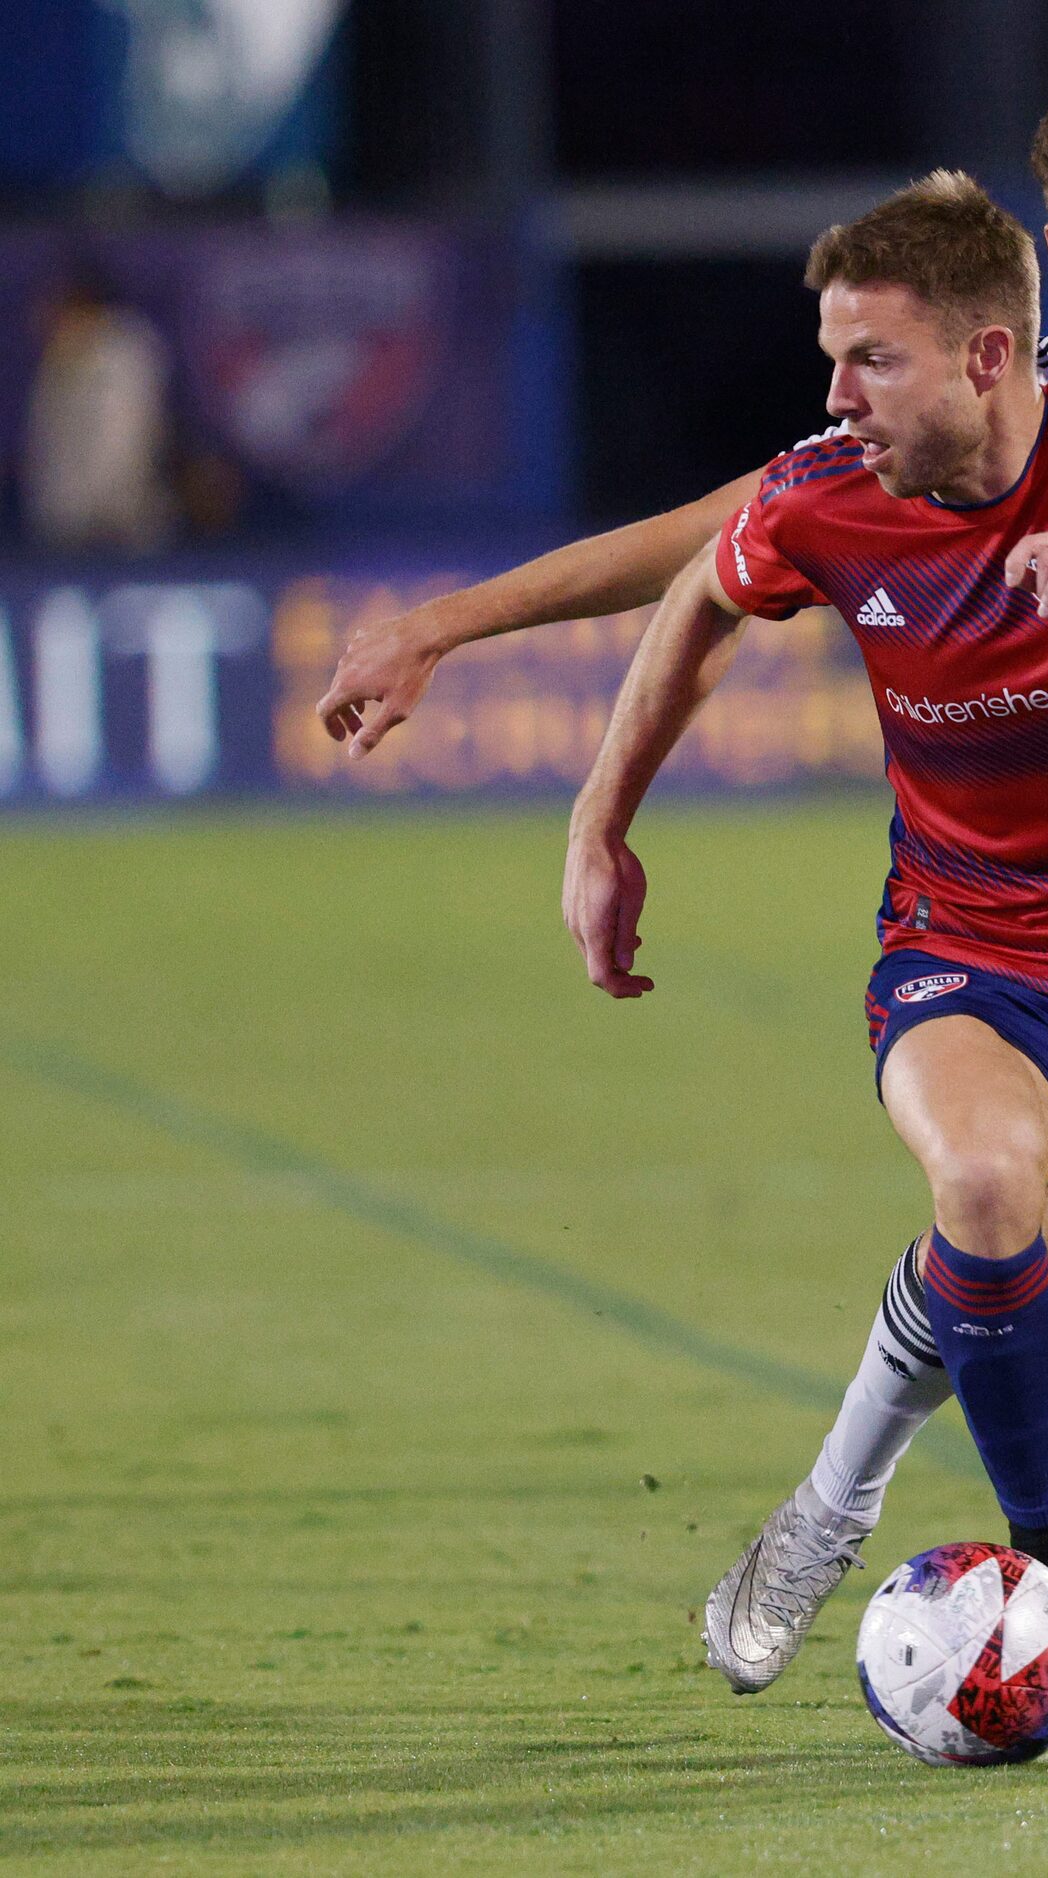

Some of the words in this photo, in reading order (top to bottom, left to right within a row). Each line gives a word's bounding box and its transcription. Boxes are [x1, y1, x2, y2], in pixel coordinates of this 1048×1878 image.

[857, 611, 906, 627] adidas
[901, 984, 915, 994] FC
[919, 977, 960, 988] DALLAS
